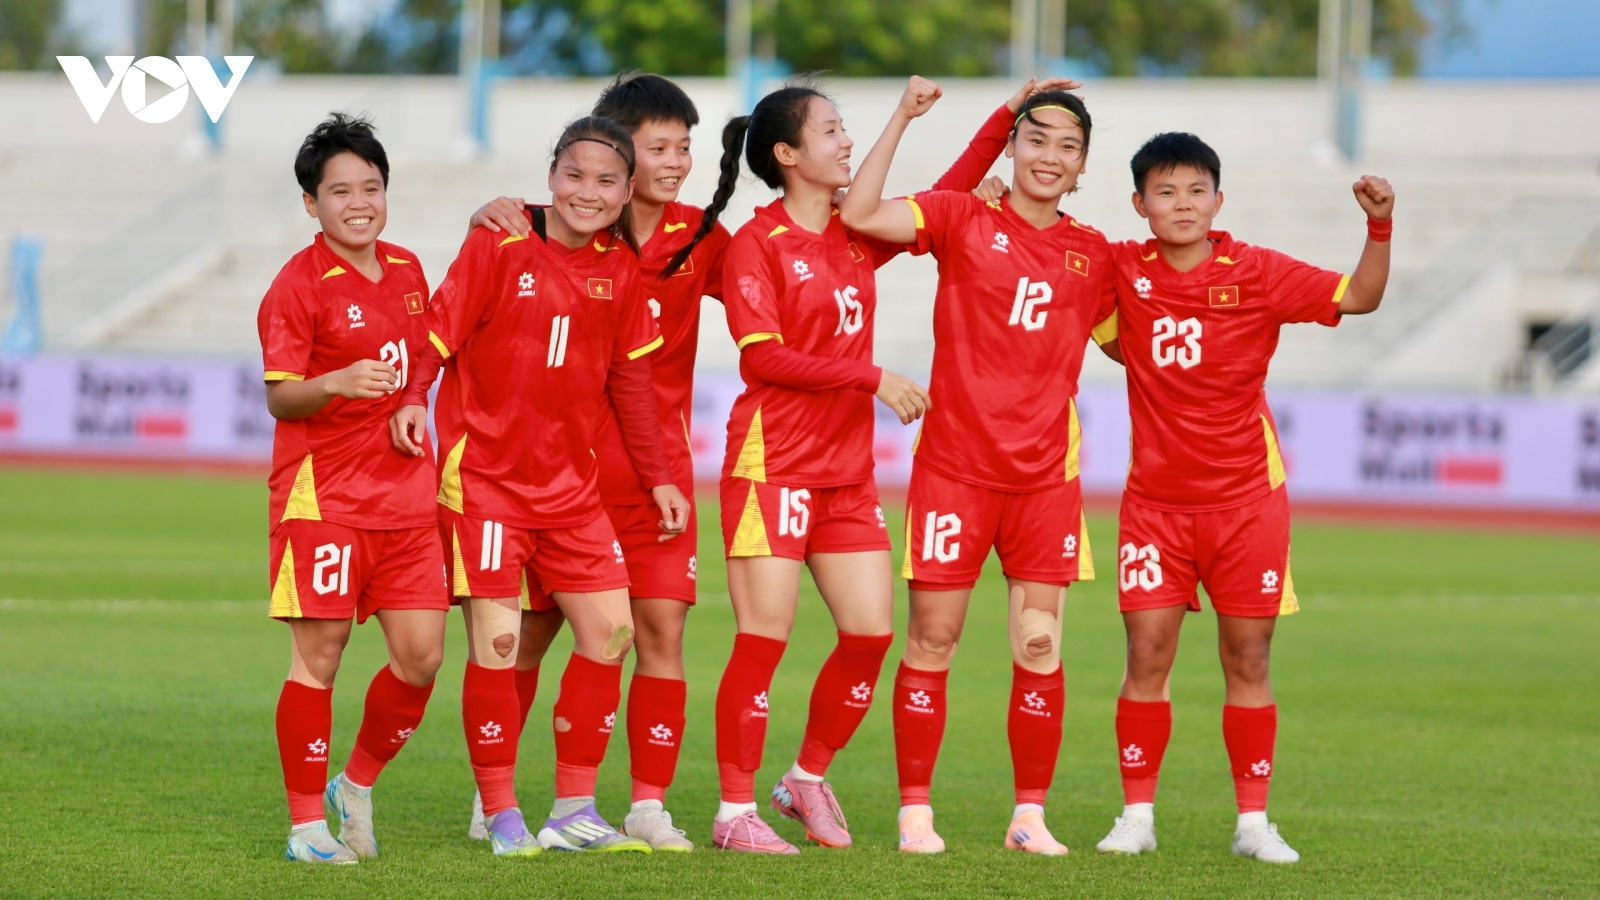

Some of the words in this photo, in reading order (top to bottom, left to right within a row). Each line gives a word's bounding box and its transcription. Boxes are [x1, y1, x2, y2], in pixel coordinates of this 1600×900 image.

[833, 284, 864, 336] 15
[1008, 276, 1053, 331] 12
[379, 337, 409, 395] 21
[547, 314, 571, 369] 11
[1151, 316, 1203, 369] 23
[778, 487, 812, 538] 15
[922, 511, 962, 564] 12
[313, 543, 353, 596] 21
[480, 520, 503, 572] 11
[1120, 542, 1164, 592] 23
